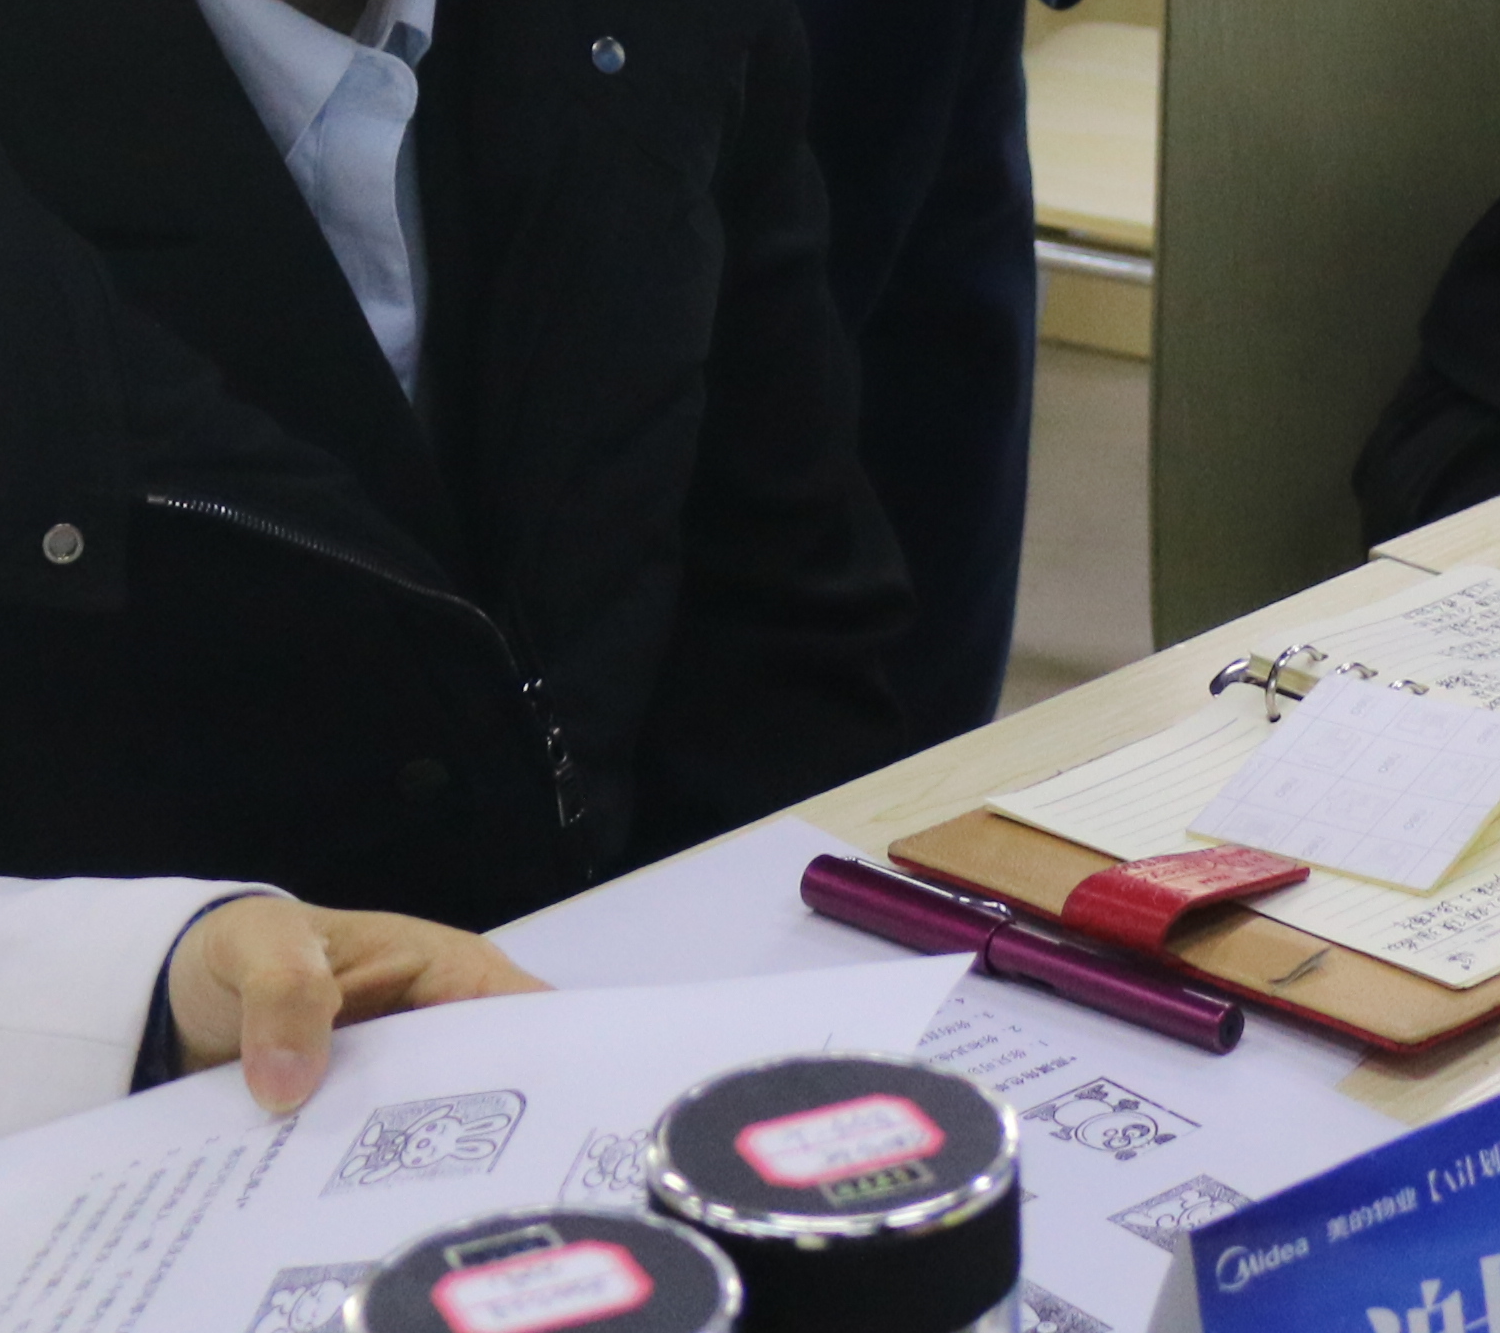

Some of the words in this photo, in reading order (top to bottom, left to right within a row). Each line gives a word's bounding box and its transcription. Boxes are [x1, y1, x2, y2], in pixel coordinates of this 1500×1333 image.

[1215, 1237, 1310, 1293] Midea
[1326, 1186, 1418, 1244] 美的物业
